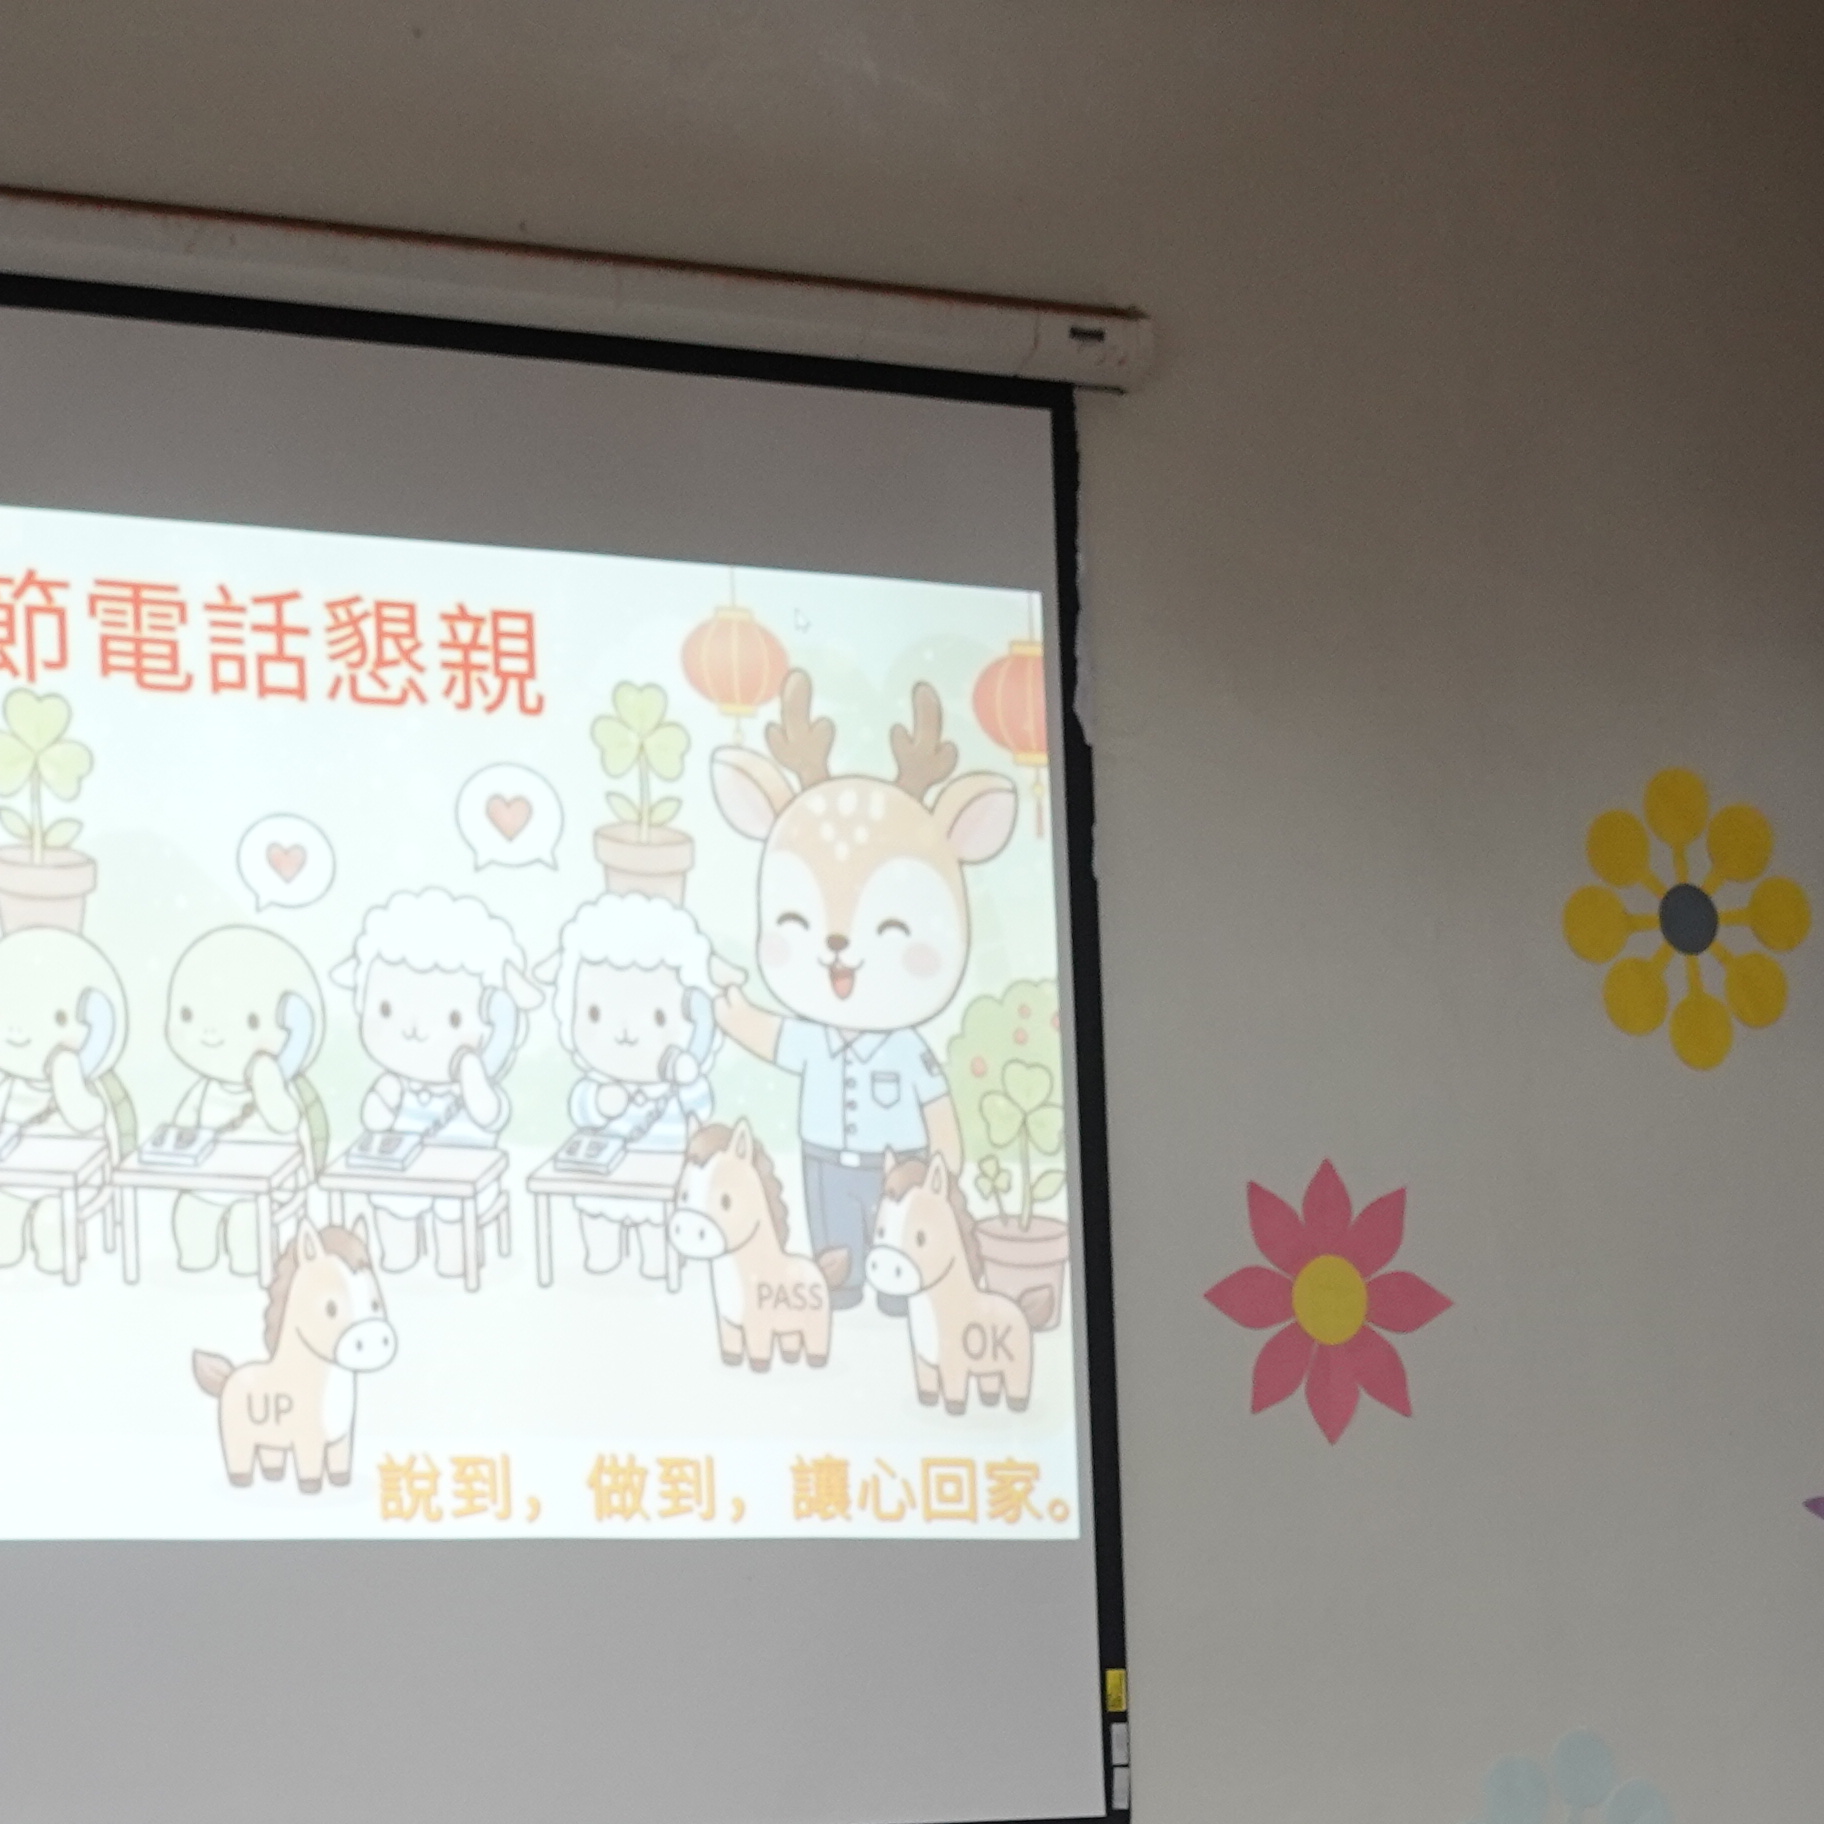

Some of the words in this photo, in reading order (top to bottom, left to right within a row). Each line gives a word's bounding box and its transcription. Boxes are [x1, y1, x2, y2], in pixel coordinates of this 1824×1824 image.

[756, 1281, 823, 1311] PASS
[961, 1321, 1014, 1362] OK
[246, 1391, 294, 1427] UP
